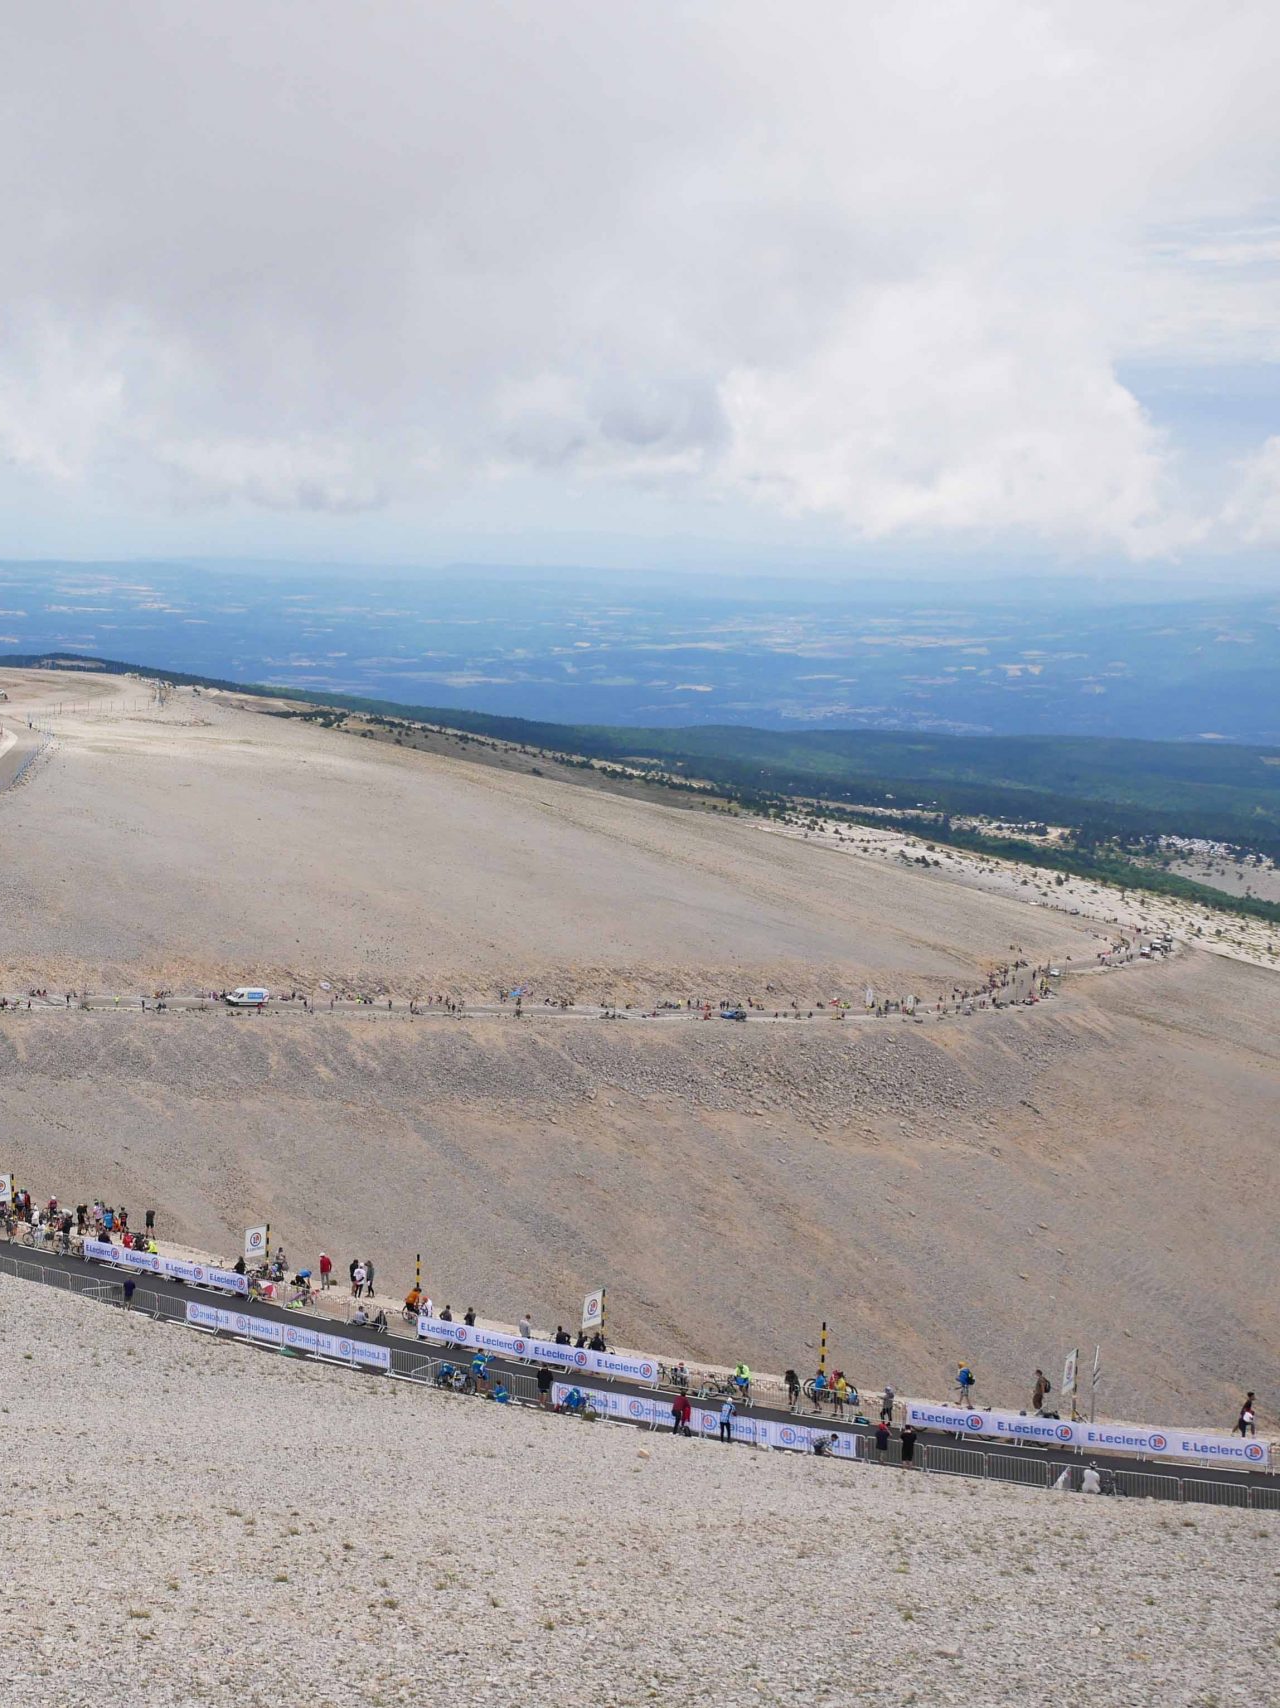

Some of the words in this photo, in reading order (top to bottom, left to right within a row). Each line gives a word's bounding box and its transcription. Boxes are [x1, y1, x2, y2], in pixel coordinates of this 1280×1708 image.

[421, 1323, 455, 1337] E.Leclerc
[476, 1335, 513, 1349] E.Leclerc
[534, 1346, 574, 1361] E.Leclerc
[597, 1359, 638, 1373] E.Leclerc
[912, 1411, 965, 1426] E.Leclerc
[997, 1422, 1054, 1436] E.Leclerc
[1088, 1432, 1148, 1447] E.Leclerc
[1182, 1441, 1242, 1456] E.Leclerc
